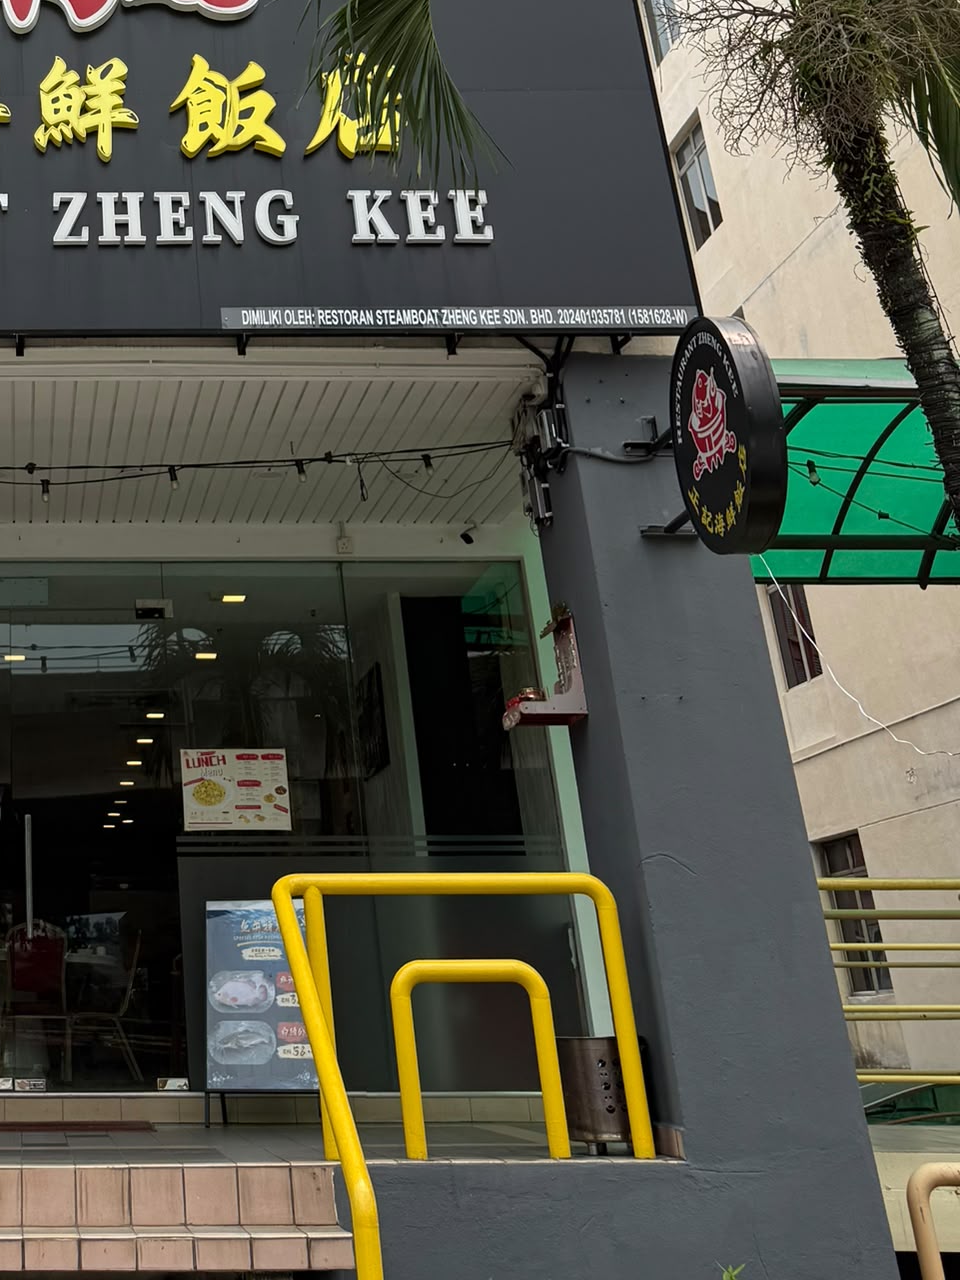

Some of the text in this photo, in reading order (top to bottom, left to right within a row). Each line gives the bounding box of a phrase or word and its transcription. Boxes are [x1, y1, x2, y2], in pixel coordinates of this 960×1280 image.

[52, 189, 300, 246] ZHENG
[347, 188, 495, 244] KEE
[241, 308, 688, 328] DIMILIKI OLEH: RESTORAN STEAMBOAT ZHENG KEE SDN. BHD. 202401035781 (1581628-W)
[696, 330, 723, 358] ZHENG
[185, 754, 227, 770] LUNCH
